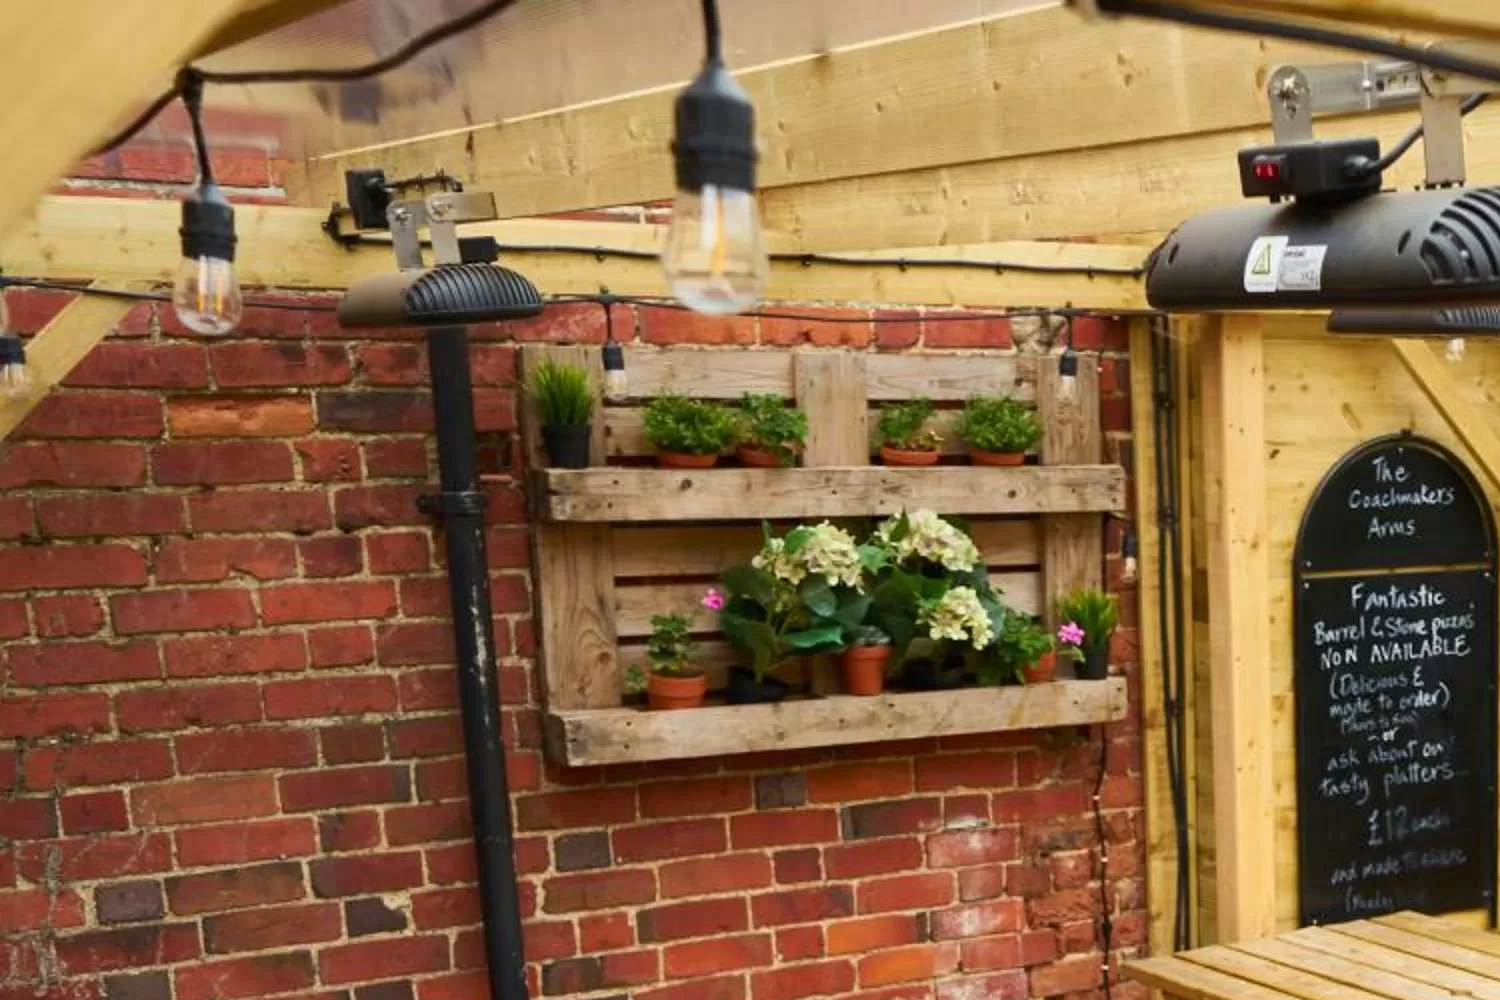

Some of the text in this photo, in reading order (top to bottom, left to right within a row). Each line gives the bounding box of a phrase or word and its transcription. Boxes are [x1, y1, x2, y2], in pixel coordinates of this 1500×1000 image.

[1372, 455, 1410, 482] The
[1348, 483, 1454, 509] Coachmakers
[1367, 515, 1416, 540] Arms
[1314, 615, 1365, 646] Barrel
[1370, 633, 1472, 665] AVAILABLE
